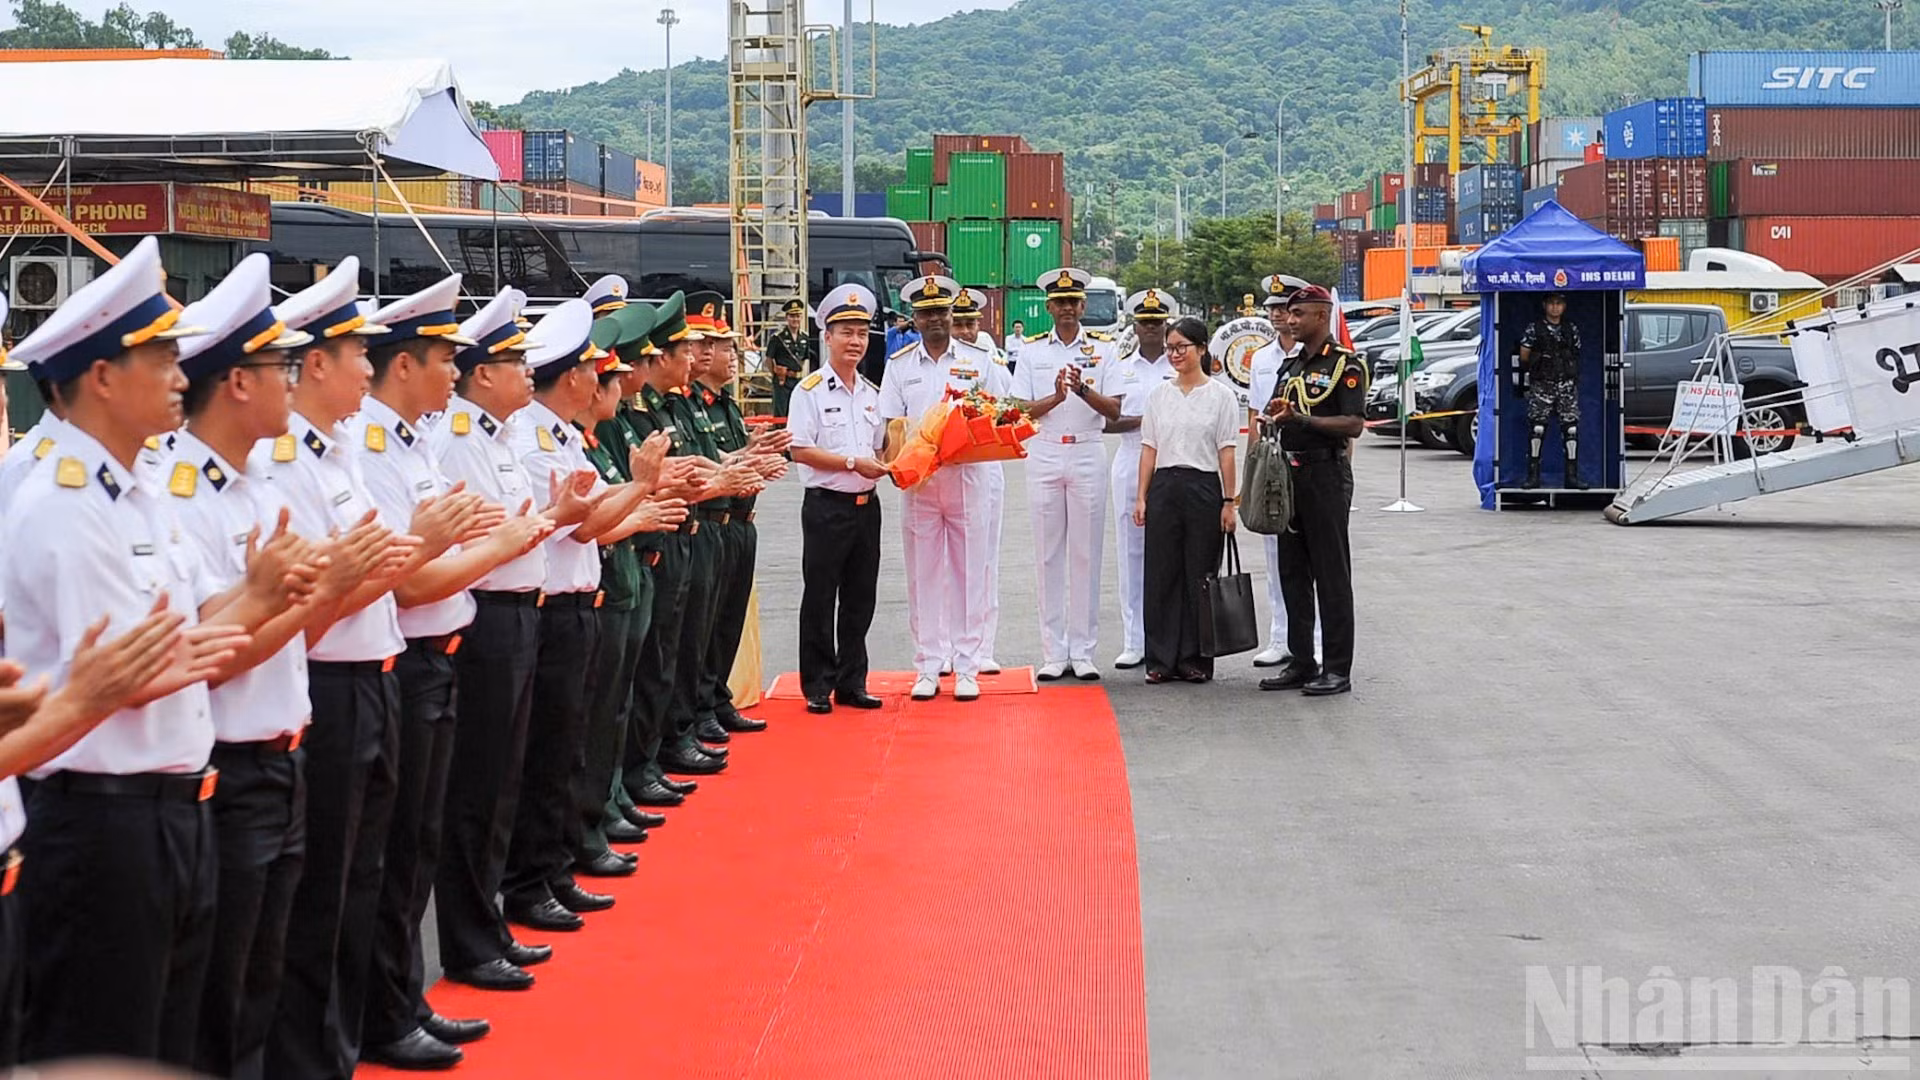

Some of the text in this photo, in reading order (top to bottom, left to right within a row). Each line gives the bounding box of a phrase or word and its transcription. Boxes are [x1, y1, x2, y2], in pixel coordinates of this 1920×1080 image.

[1762, 67, 1876, 89] SITC
[75, 200, 147, 220] PHÒNG
[1771, 226, 1791, 239] CAI
[1581, 270, 1636, 282] INS DELHI
